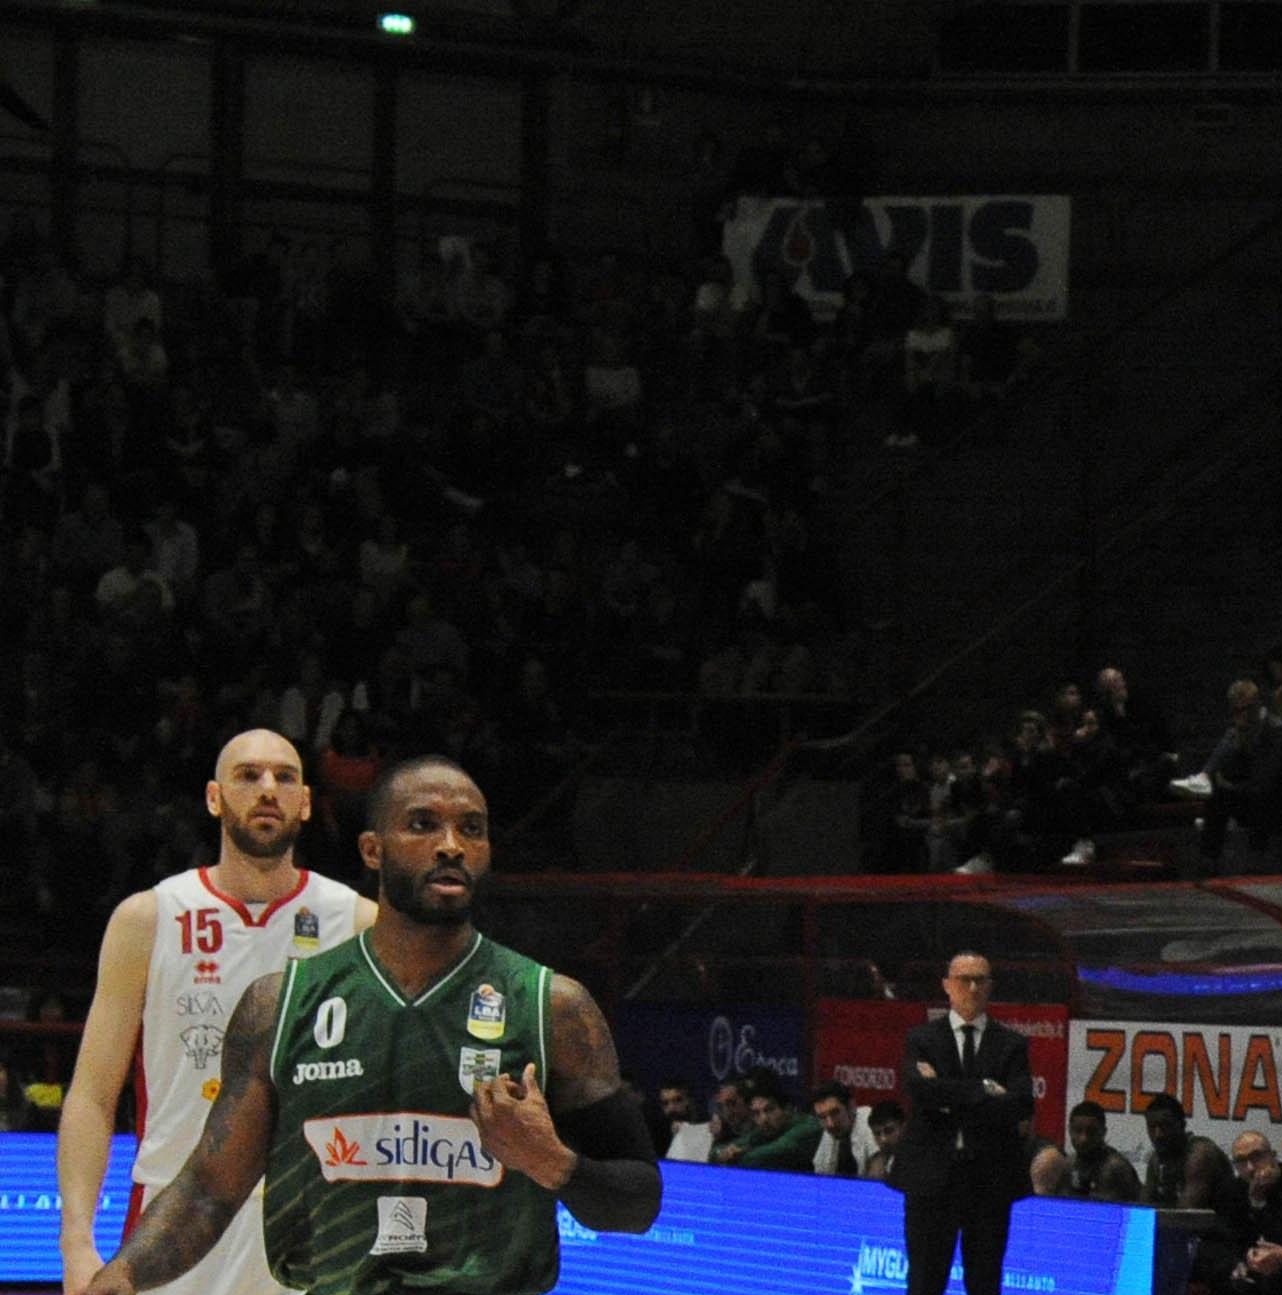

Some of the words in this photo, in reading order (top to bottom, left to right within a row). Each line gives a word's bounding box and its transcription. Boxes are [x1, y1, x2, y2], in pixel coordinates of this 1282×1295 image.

[752, 203, 1038, 292] AVIS
[174, 907, 223, 954] 15
[314, 996, 348, 1049] 0
